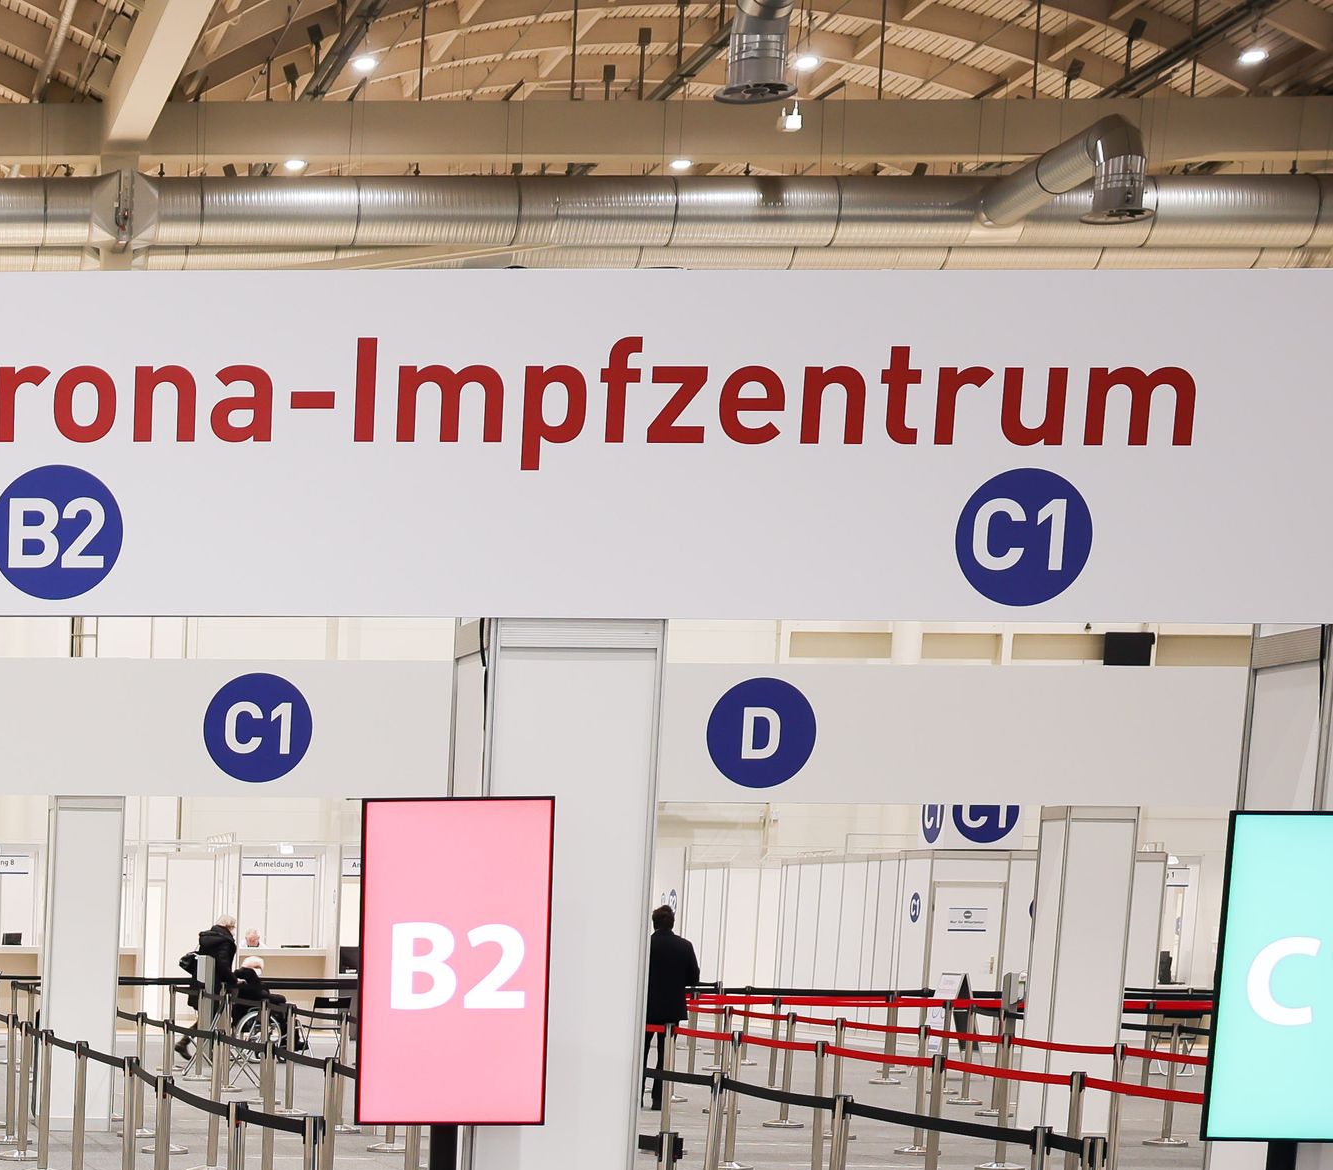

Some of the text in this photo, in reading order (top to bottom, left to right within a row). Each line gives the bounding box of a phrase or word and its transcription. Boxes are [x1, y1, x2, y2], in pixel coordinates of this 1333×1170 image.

[8, 497, 104, 568] B2
[973, 498, 1066, 570] C1
[225, 702, 292, 754] C1
[742, 707, 780, 759] D
[254, 860, 293, 869] Anmeldung
[390, 922, 525, 1010] B2
[1246, 936, 1322, 1026] C
